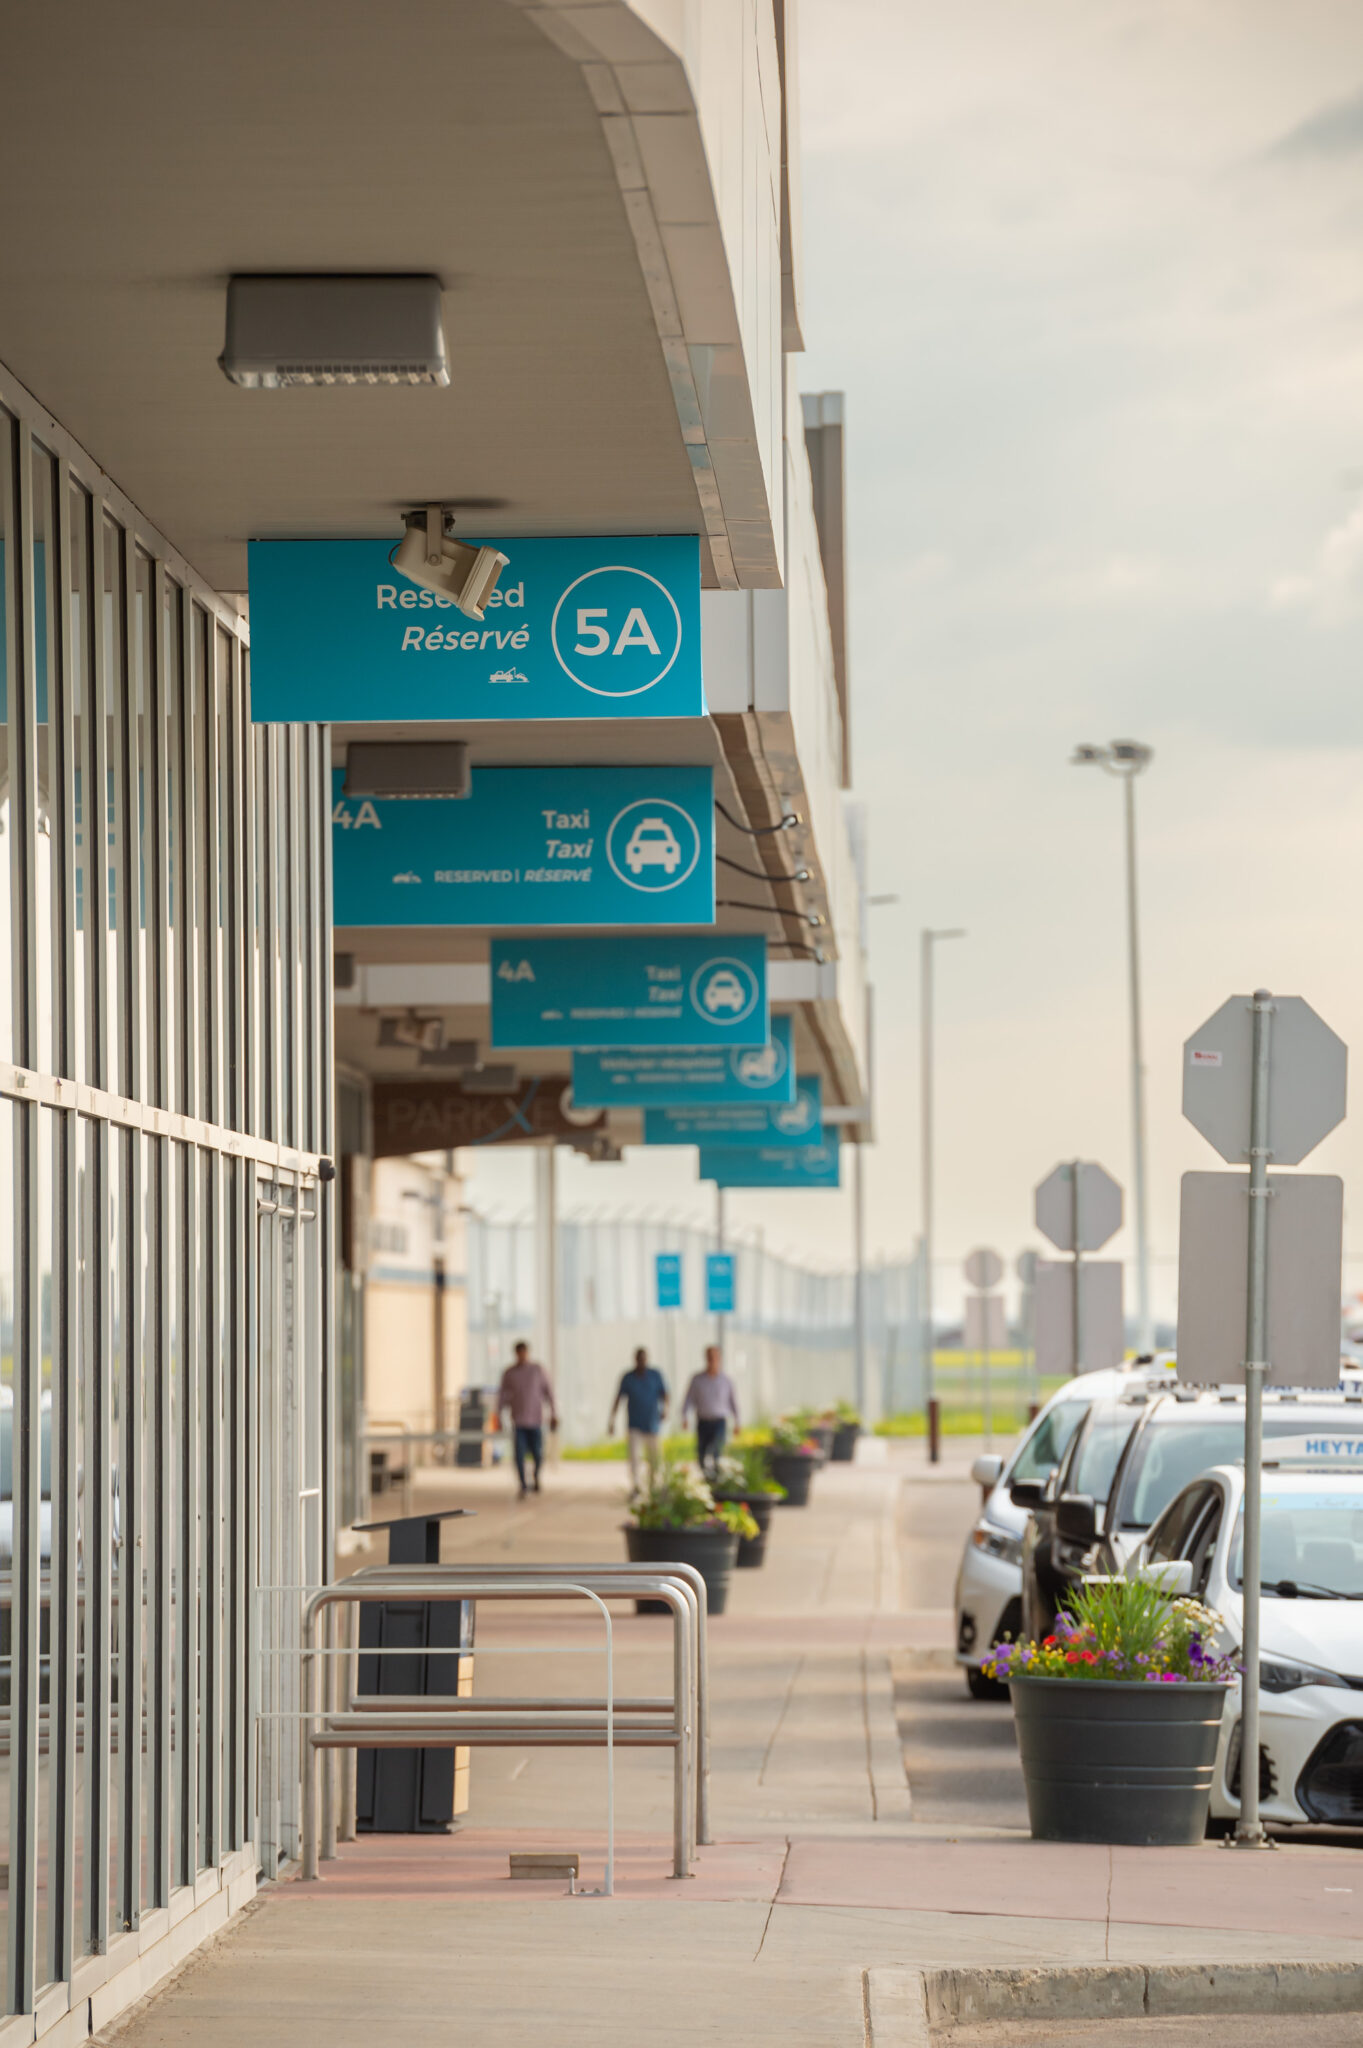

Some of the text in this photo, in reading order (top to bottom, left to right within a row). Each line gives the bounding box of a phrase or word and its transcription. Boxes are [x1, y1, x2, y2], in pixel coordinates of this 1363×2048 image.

[377, 582, 525, 610] Reseed
[401, 623, 530, 651] Réservé
[574, 608, 662, 656] 5A
[332, 800, 382, 830] 4A
[542, 809, 590, 829] Taxi
[546, 838, 594, 859] Taxi
[434, 869, 513, 883] RESERVED
[524, 867, 593, 883] RÉSERVÉ
[497, 960, 536, 982] 4A
